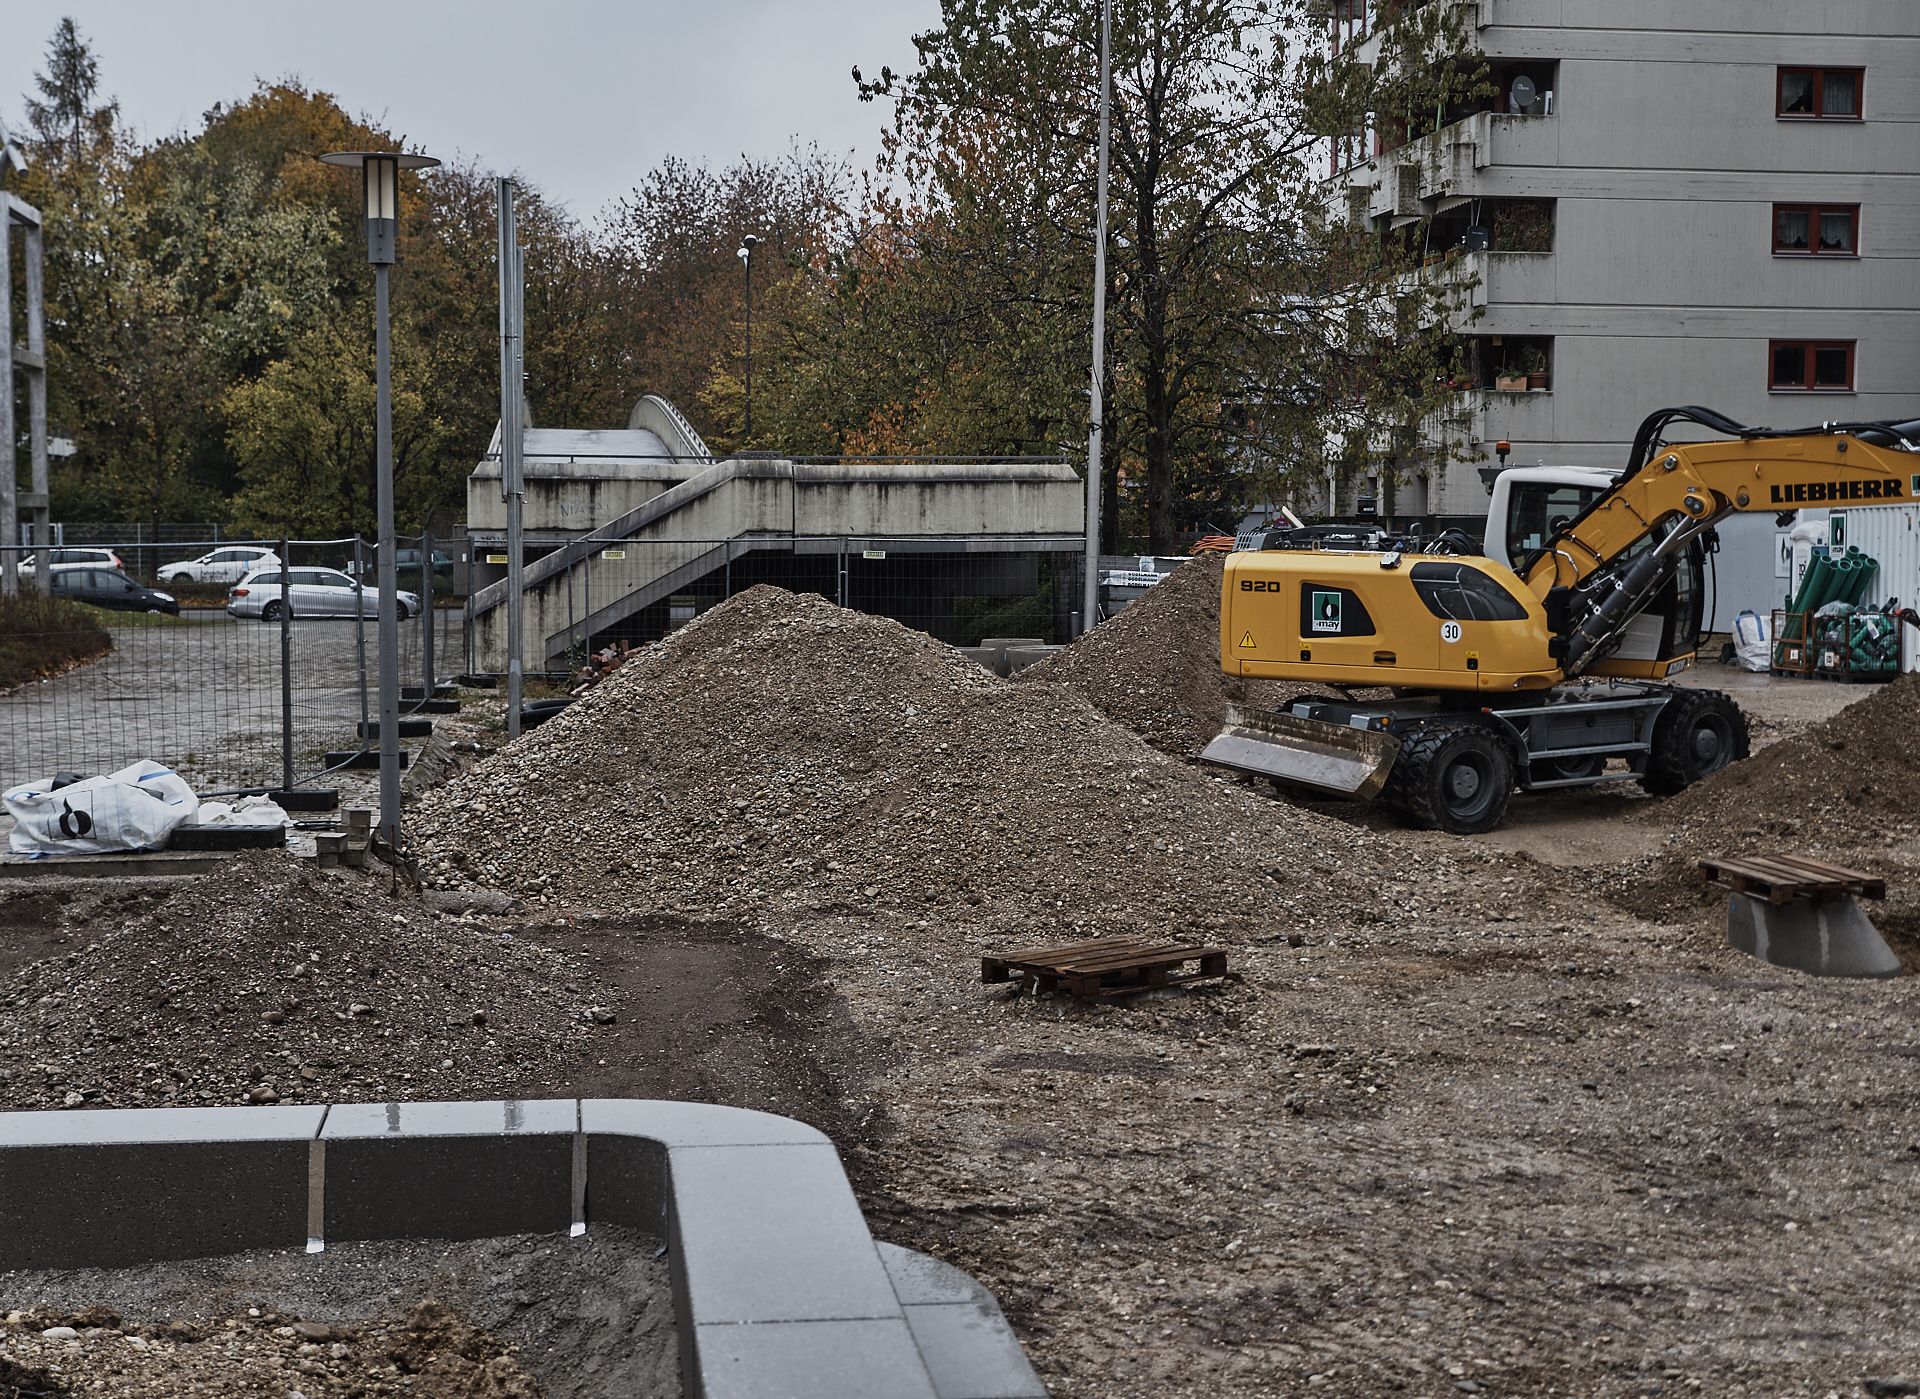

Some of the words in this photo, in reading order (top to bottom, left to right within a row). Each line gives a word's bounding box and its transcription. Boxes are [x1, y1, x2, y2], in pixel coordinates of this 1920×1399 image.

[1770, 479, 1903, 503] LIEBHERR
[1241, 580, 1280, 593] 920
[1445, 624, 1458, 639] 30
